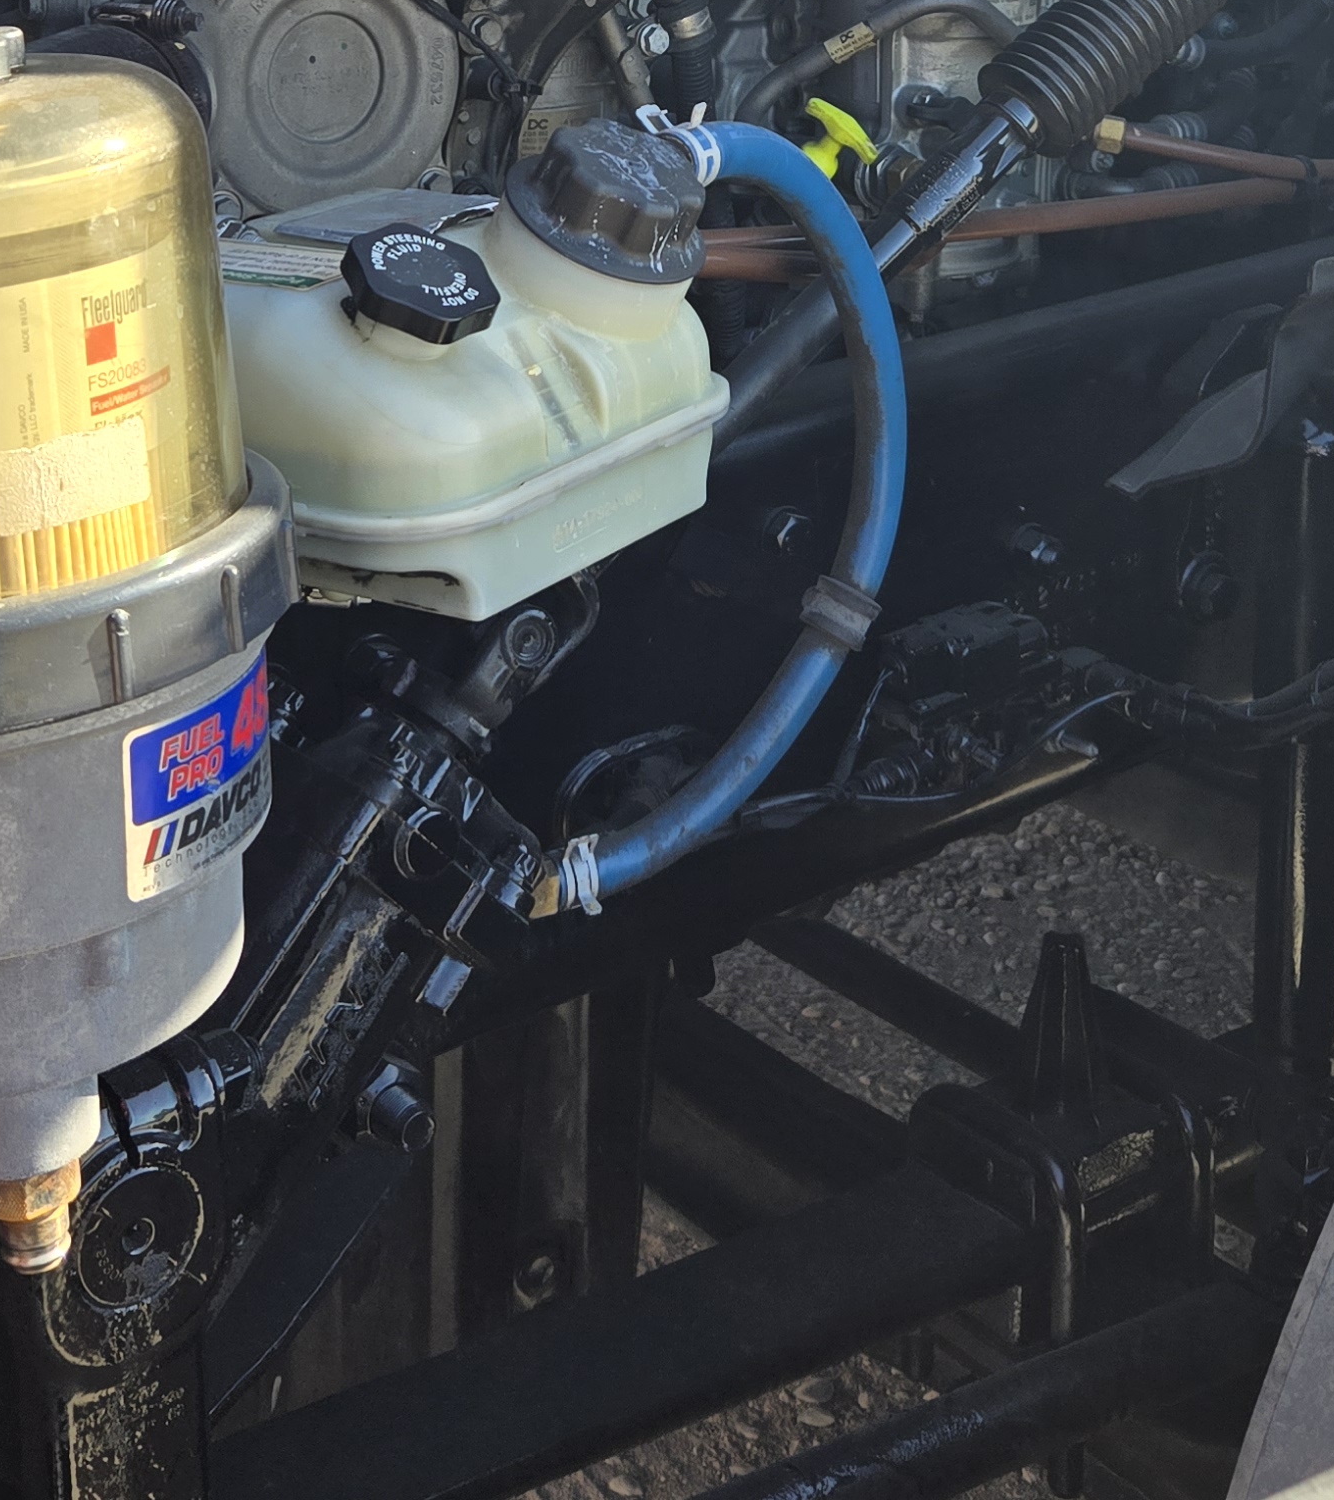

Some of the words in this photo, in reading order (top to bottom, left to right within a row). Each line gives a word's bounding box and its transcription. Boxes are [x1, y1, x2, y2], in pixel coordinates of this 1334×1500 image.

[528, 118, 549, 130] DC
[371, 241, 388, 270] POWER
[383, 233, 446, 251] STEERING
[386, 243, 422, 261] FLUID
[421, 272, 467, 297] OVERFILL
[463, 287, 480, 301] DO
[19, 297, 27, 315] USA
[81, 278, 148, 329] Fleetguard
[441, 295, 467, 307] NOT
[21, 317, 28, 327] IN
[22, 328, 30, 353] MADE
[88, 360, 147, 391] FS20083
[159, 713, 225, 773] FUEL
[168, 746, 225, 802] PRO
[177, 758, 261, 851] DAVCO
